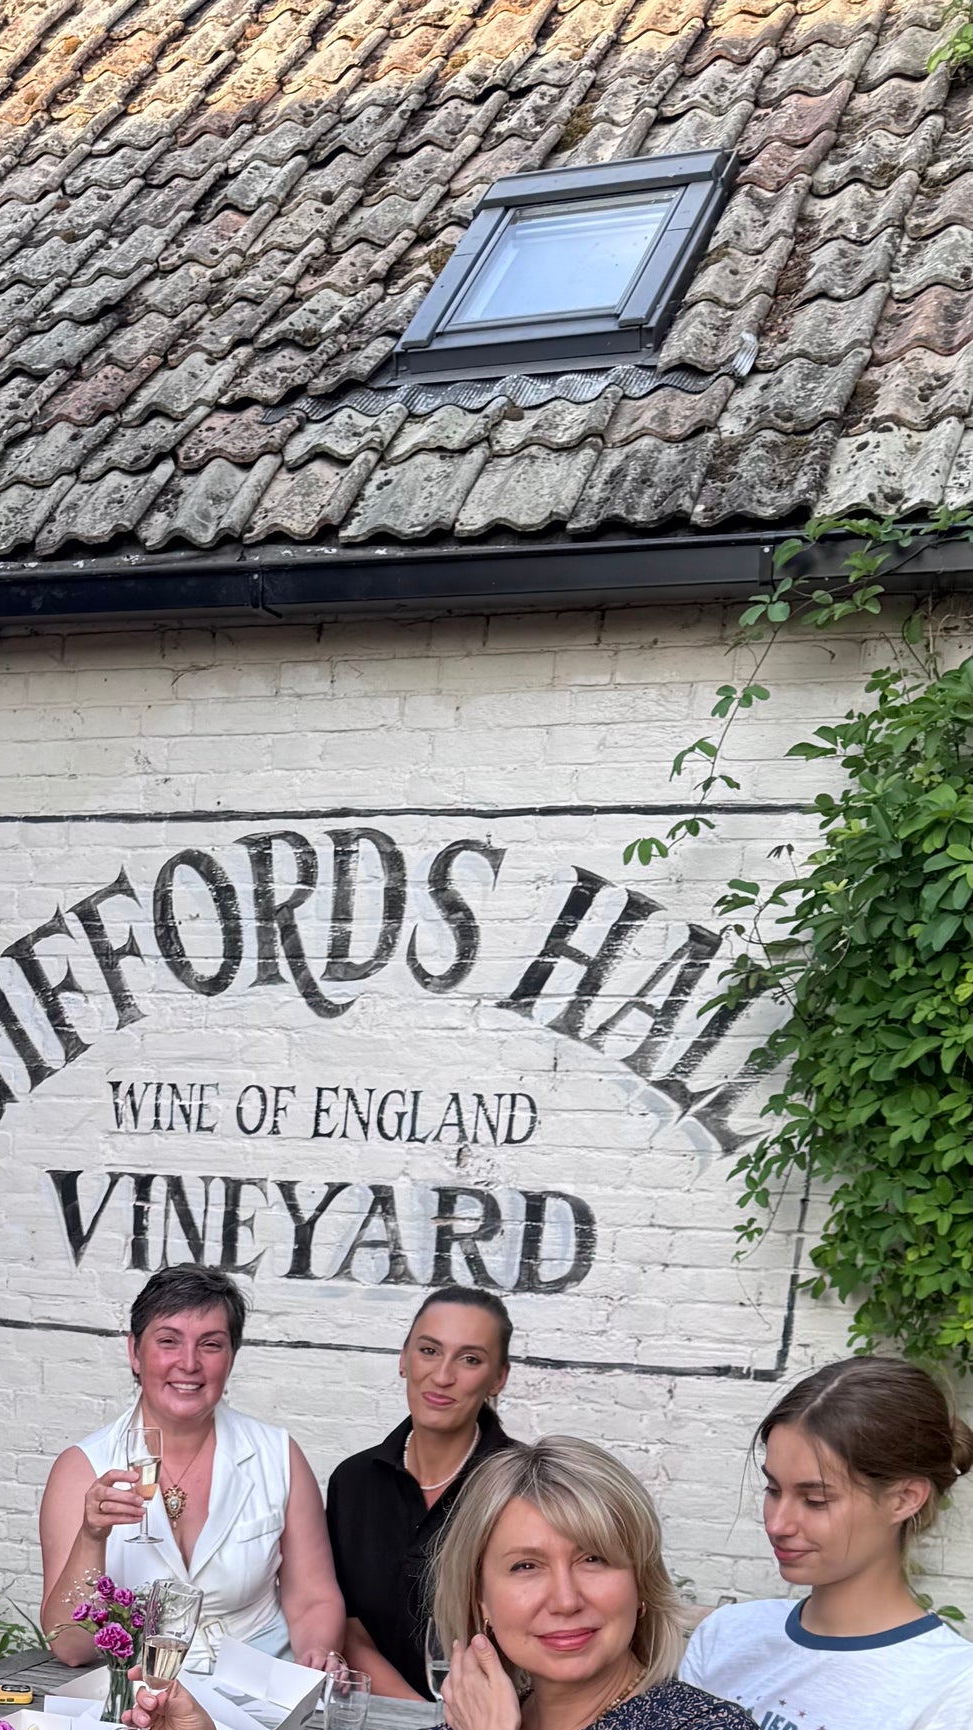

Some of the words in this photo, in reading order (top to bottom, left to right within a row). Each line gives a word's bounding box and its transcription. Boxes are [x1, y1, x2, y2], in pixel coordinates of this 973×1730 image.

[107, 1080, 220, 1133] WINE
[236, 1084, 297, 1136] OF
[310, 1085, 540, 1147] ENGLAND
[45, 1169, 599, 1294] VINEYARD
